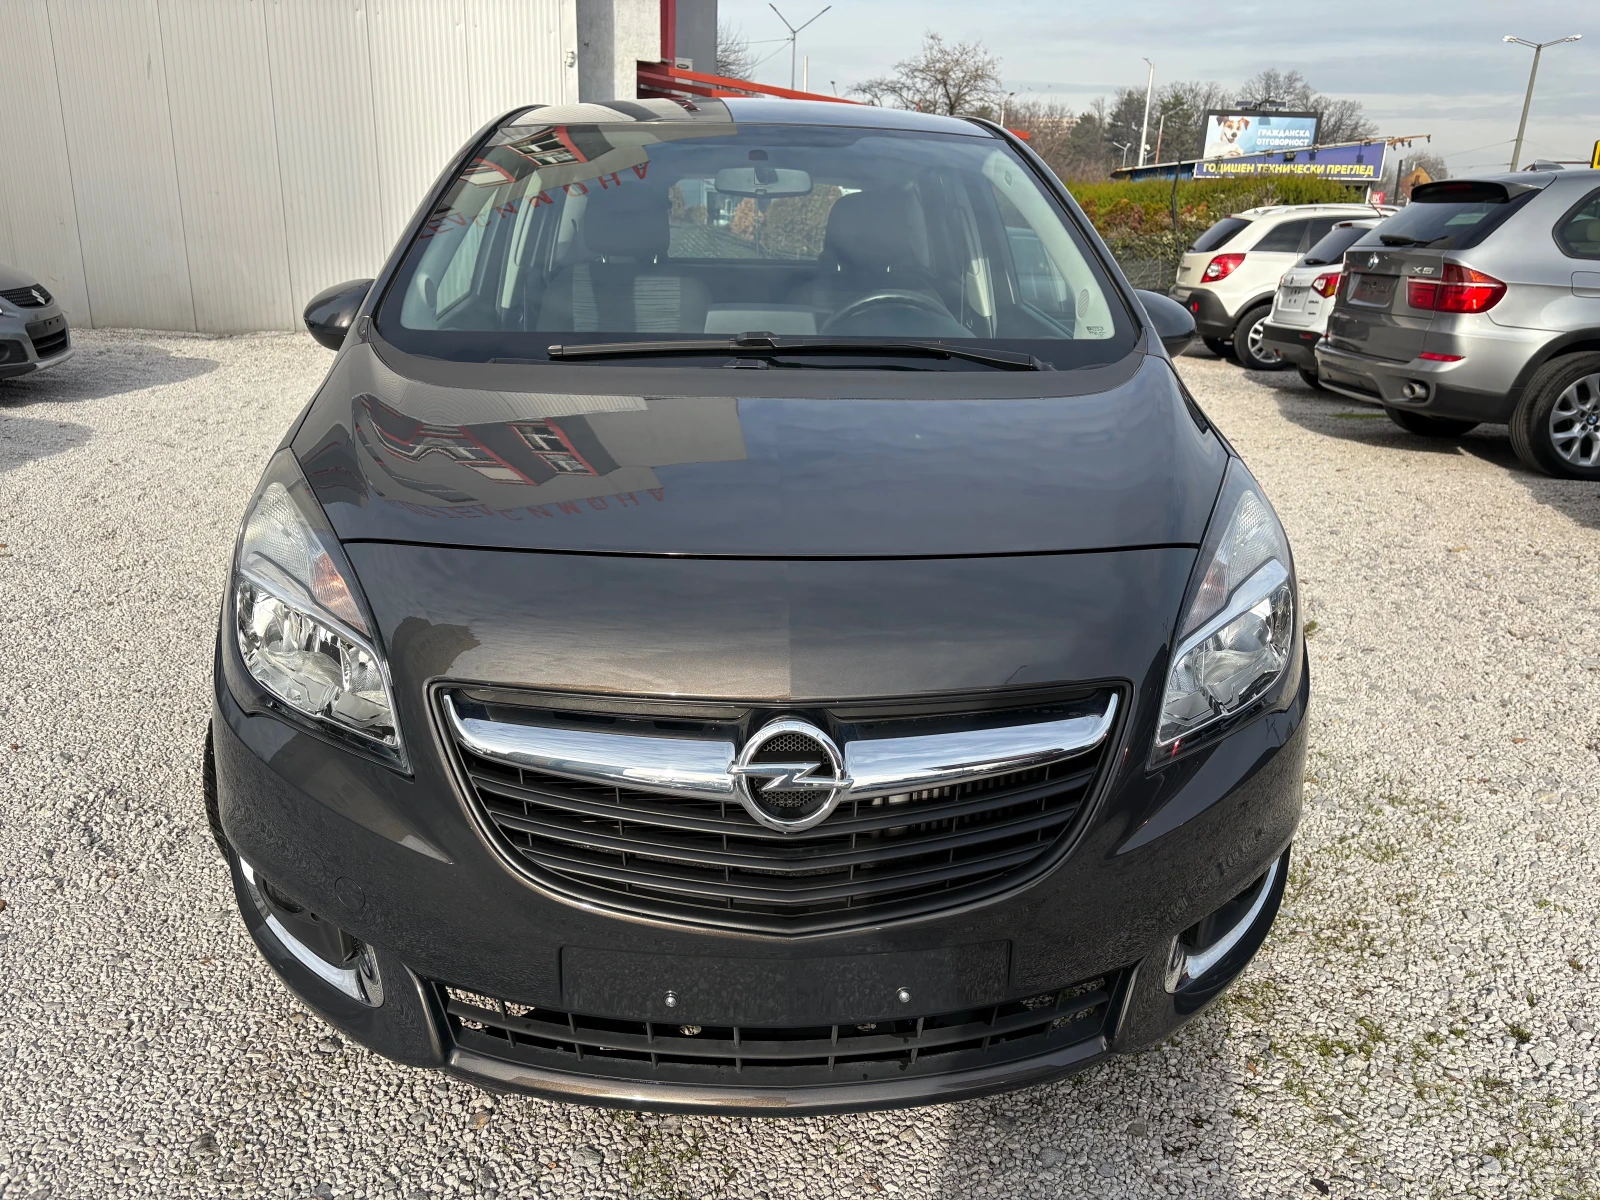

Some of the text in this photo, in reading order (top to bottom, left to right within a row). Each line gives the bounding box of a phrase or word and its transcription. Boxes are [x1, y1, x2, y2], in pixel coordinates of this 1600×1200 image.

[1257, 128, 1310, 138] ГРАЖДАНСКА
[1256, 138, 1309, 146] ОТГОВОРНОСТ
[1203, 163, 1375, 176] ГОДИШЕН ТЕХНИЧЕСКИ ПРЕГЛЕД
[1411, 266, 1435, 274] X5
[757, 724, 825, 740] OPEL
